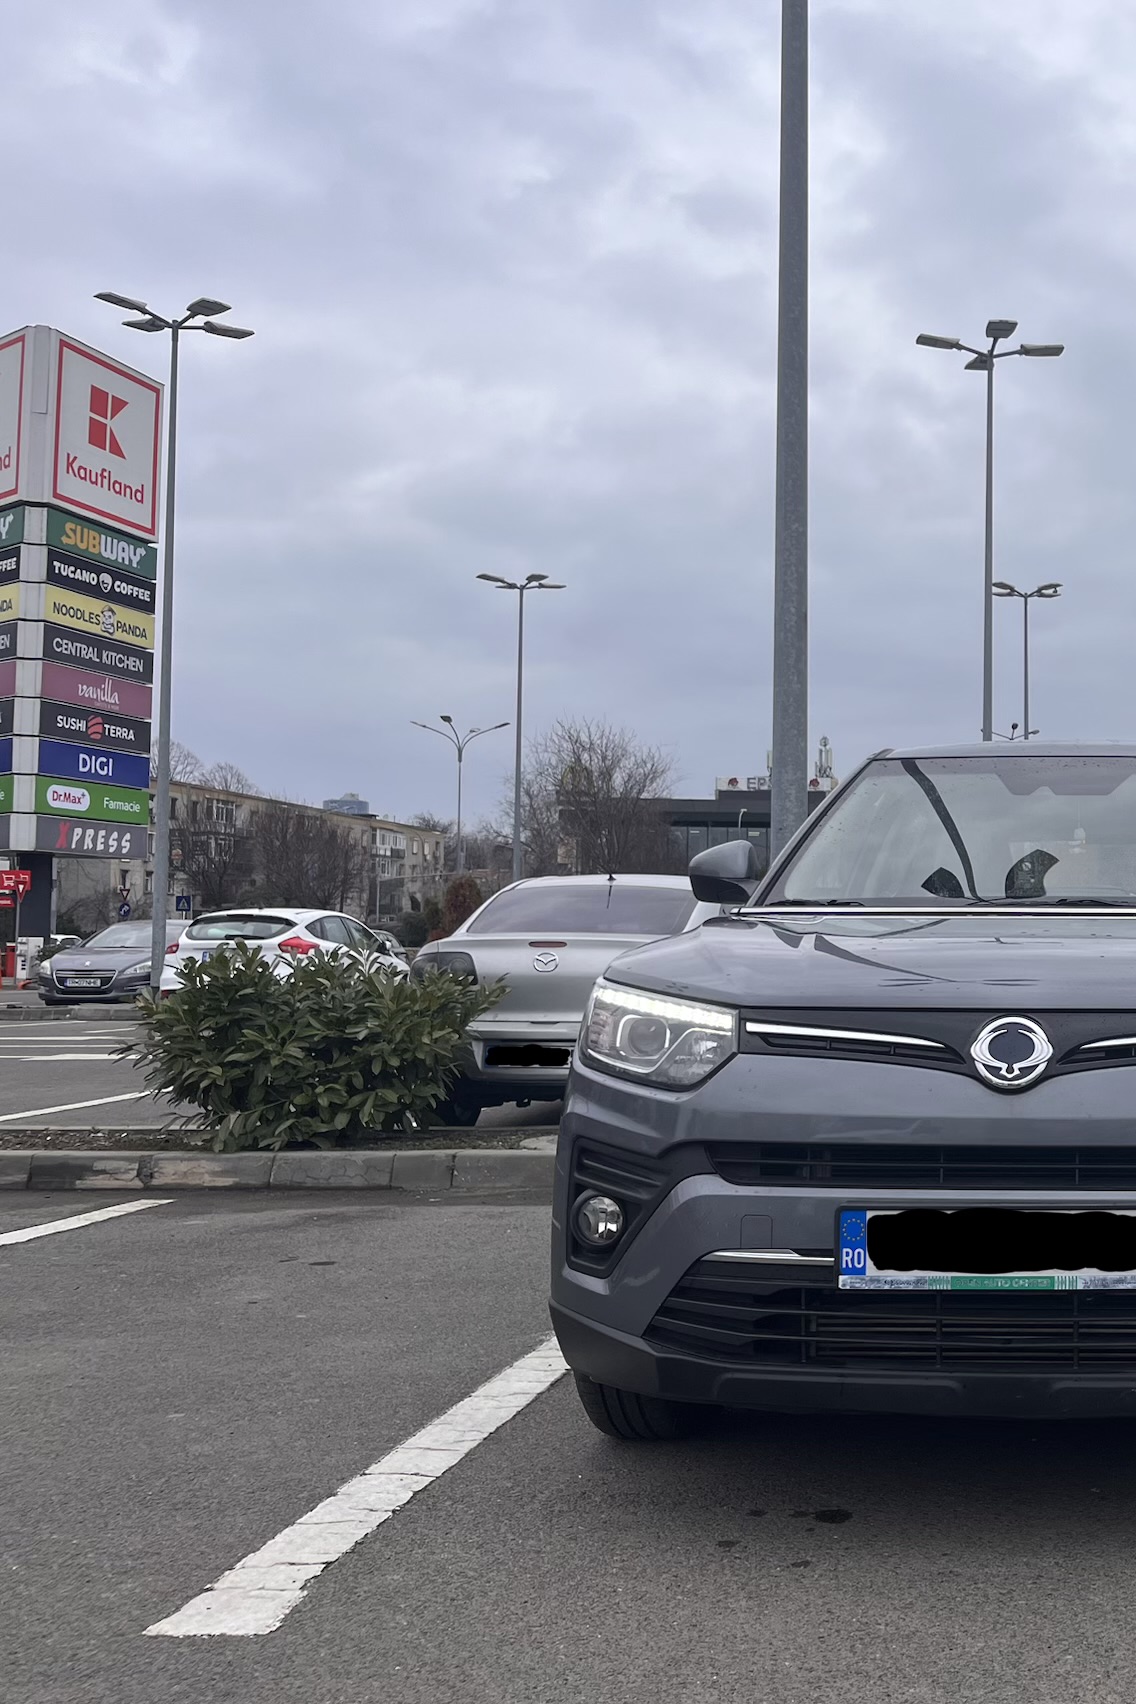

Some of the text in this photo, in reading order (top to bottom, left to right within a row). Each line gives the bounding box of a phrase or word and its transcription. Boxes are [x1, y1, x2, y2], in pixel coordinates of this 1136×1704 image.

[66, 452, 144, 504] Kaufland
[61, 522, 146, 567] SUBWAY
[53, 561, 151, 602] TUCANO COFFEE
[53, 601, 148, 640] NOODLES PANDA
[53, 637, 144, 673] CENTRAL KITCHEN
[78, 677, 120, 704] vanilla
[56, 715, 135, 741] SUSHI TERRA
[78, 753, 113, 777] DIGI
[103, 797, 141, 813] Farmacie
[55, 822, 131, 854] XPRESS
[841, 1247, 865, 1269] RO
